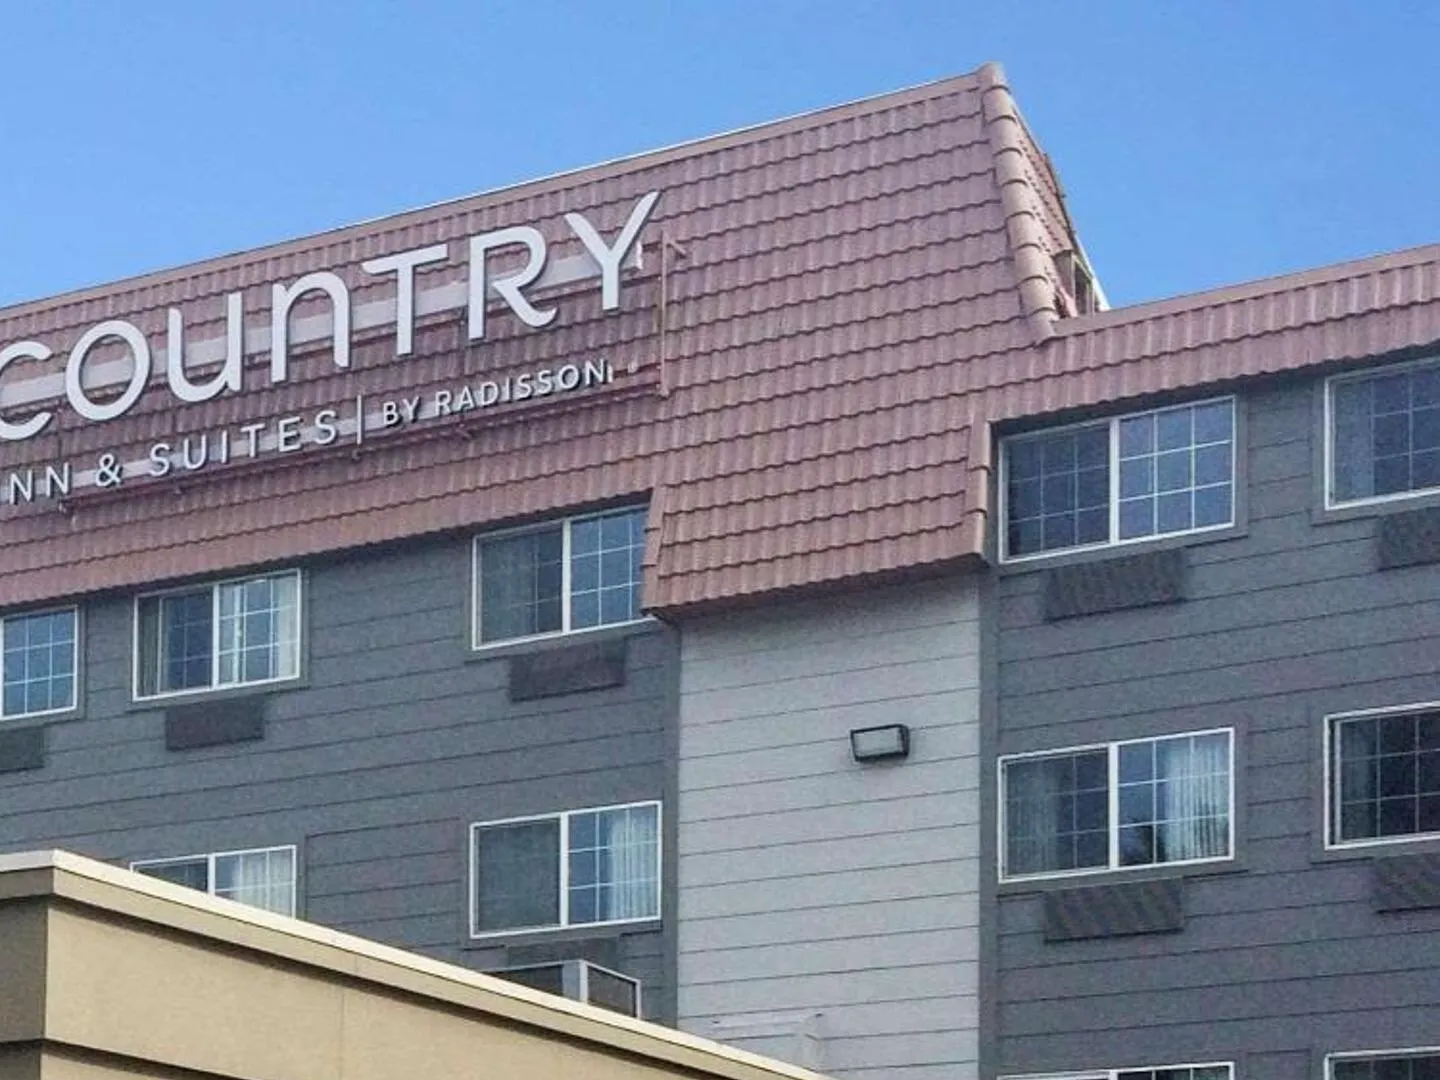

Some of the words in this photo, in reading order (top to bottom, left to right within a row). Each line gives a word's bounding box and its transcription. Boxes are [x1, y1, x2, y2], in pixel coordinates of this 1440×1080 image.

[94, 452, 122, 488] &
[148, 408, 338, 478] SUITES
[381, 396, 420, 426] BY
[433, 358, 607, 417] RADISSON
